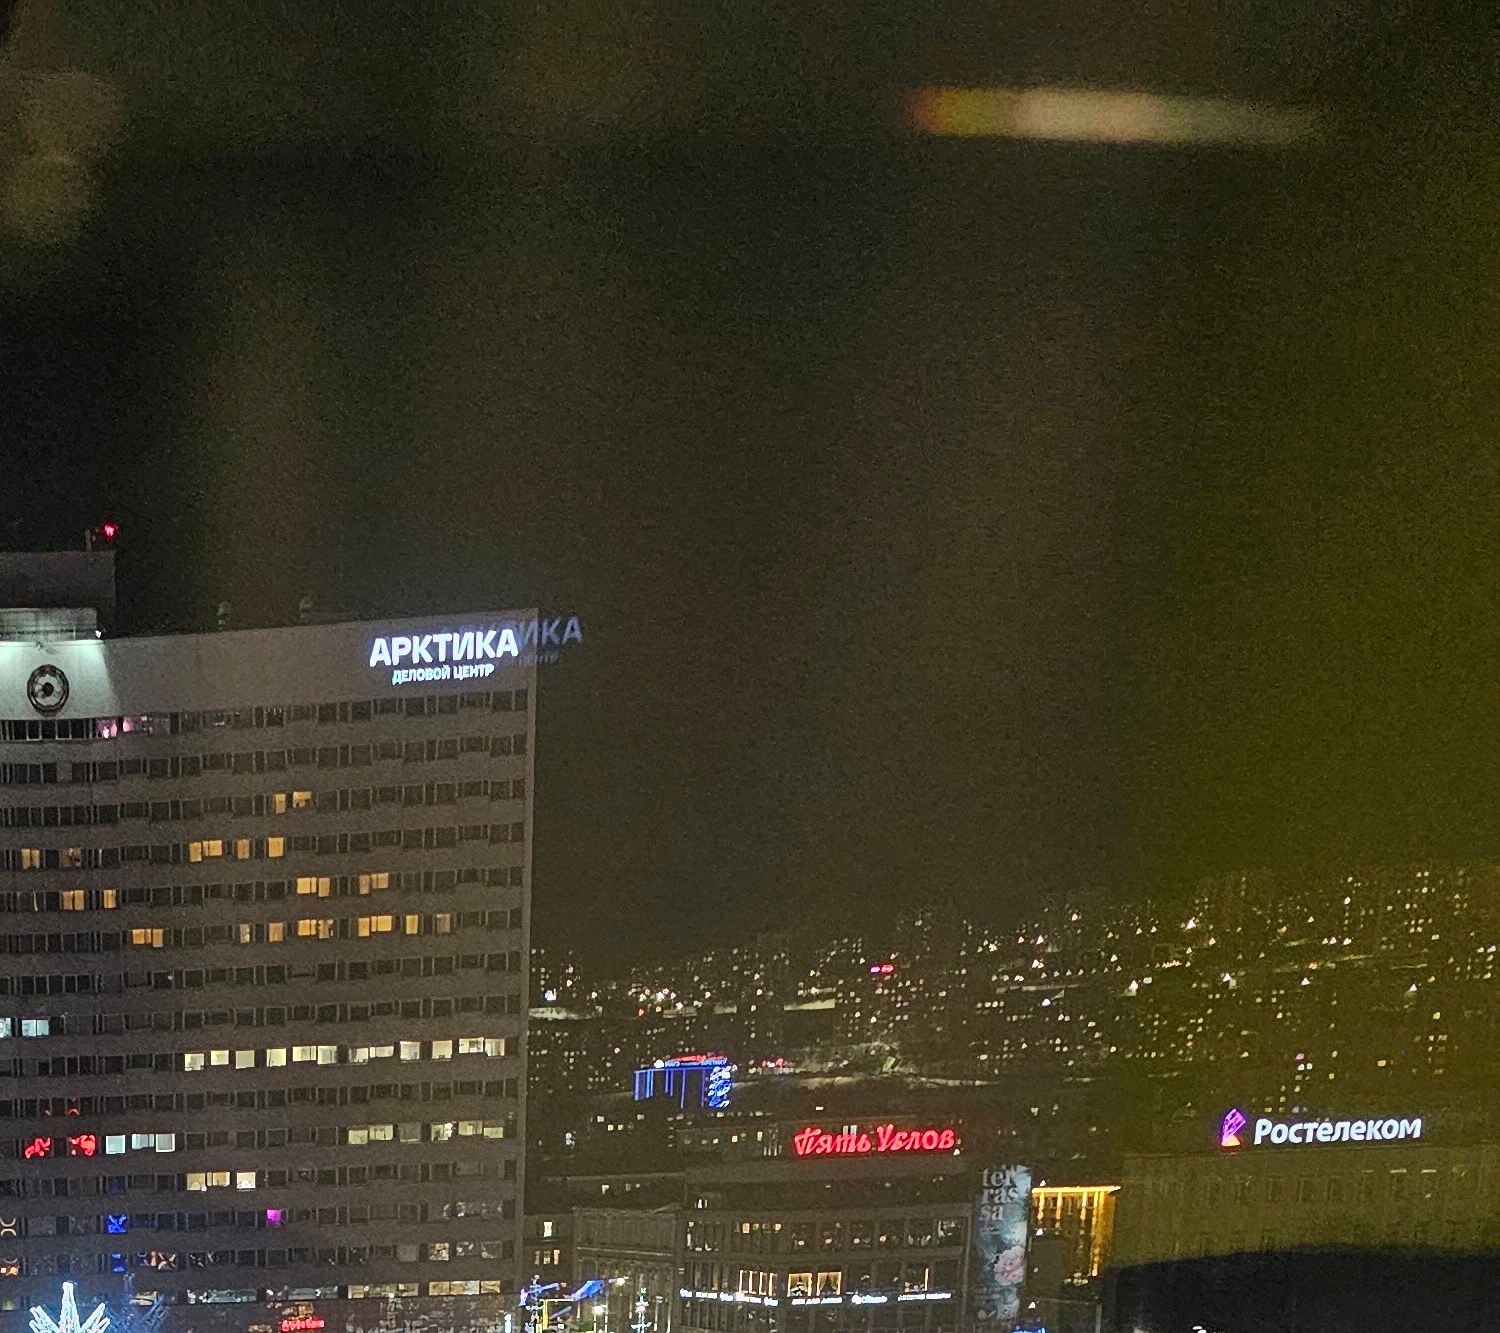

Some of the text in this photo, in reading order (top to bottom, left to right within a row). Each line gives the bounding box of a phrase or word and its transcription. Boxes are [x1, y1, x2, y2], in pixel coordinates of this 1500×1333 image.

[369, 628, 518, 667] АРКТИКА
[392, 663, 495, 685] ДЕЛОВОЙ ЦЕНТР
[1254, 1118, 1422, 1145] Ростелеком
[980, 1204, 1004, 1221] sa
